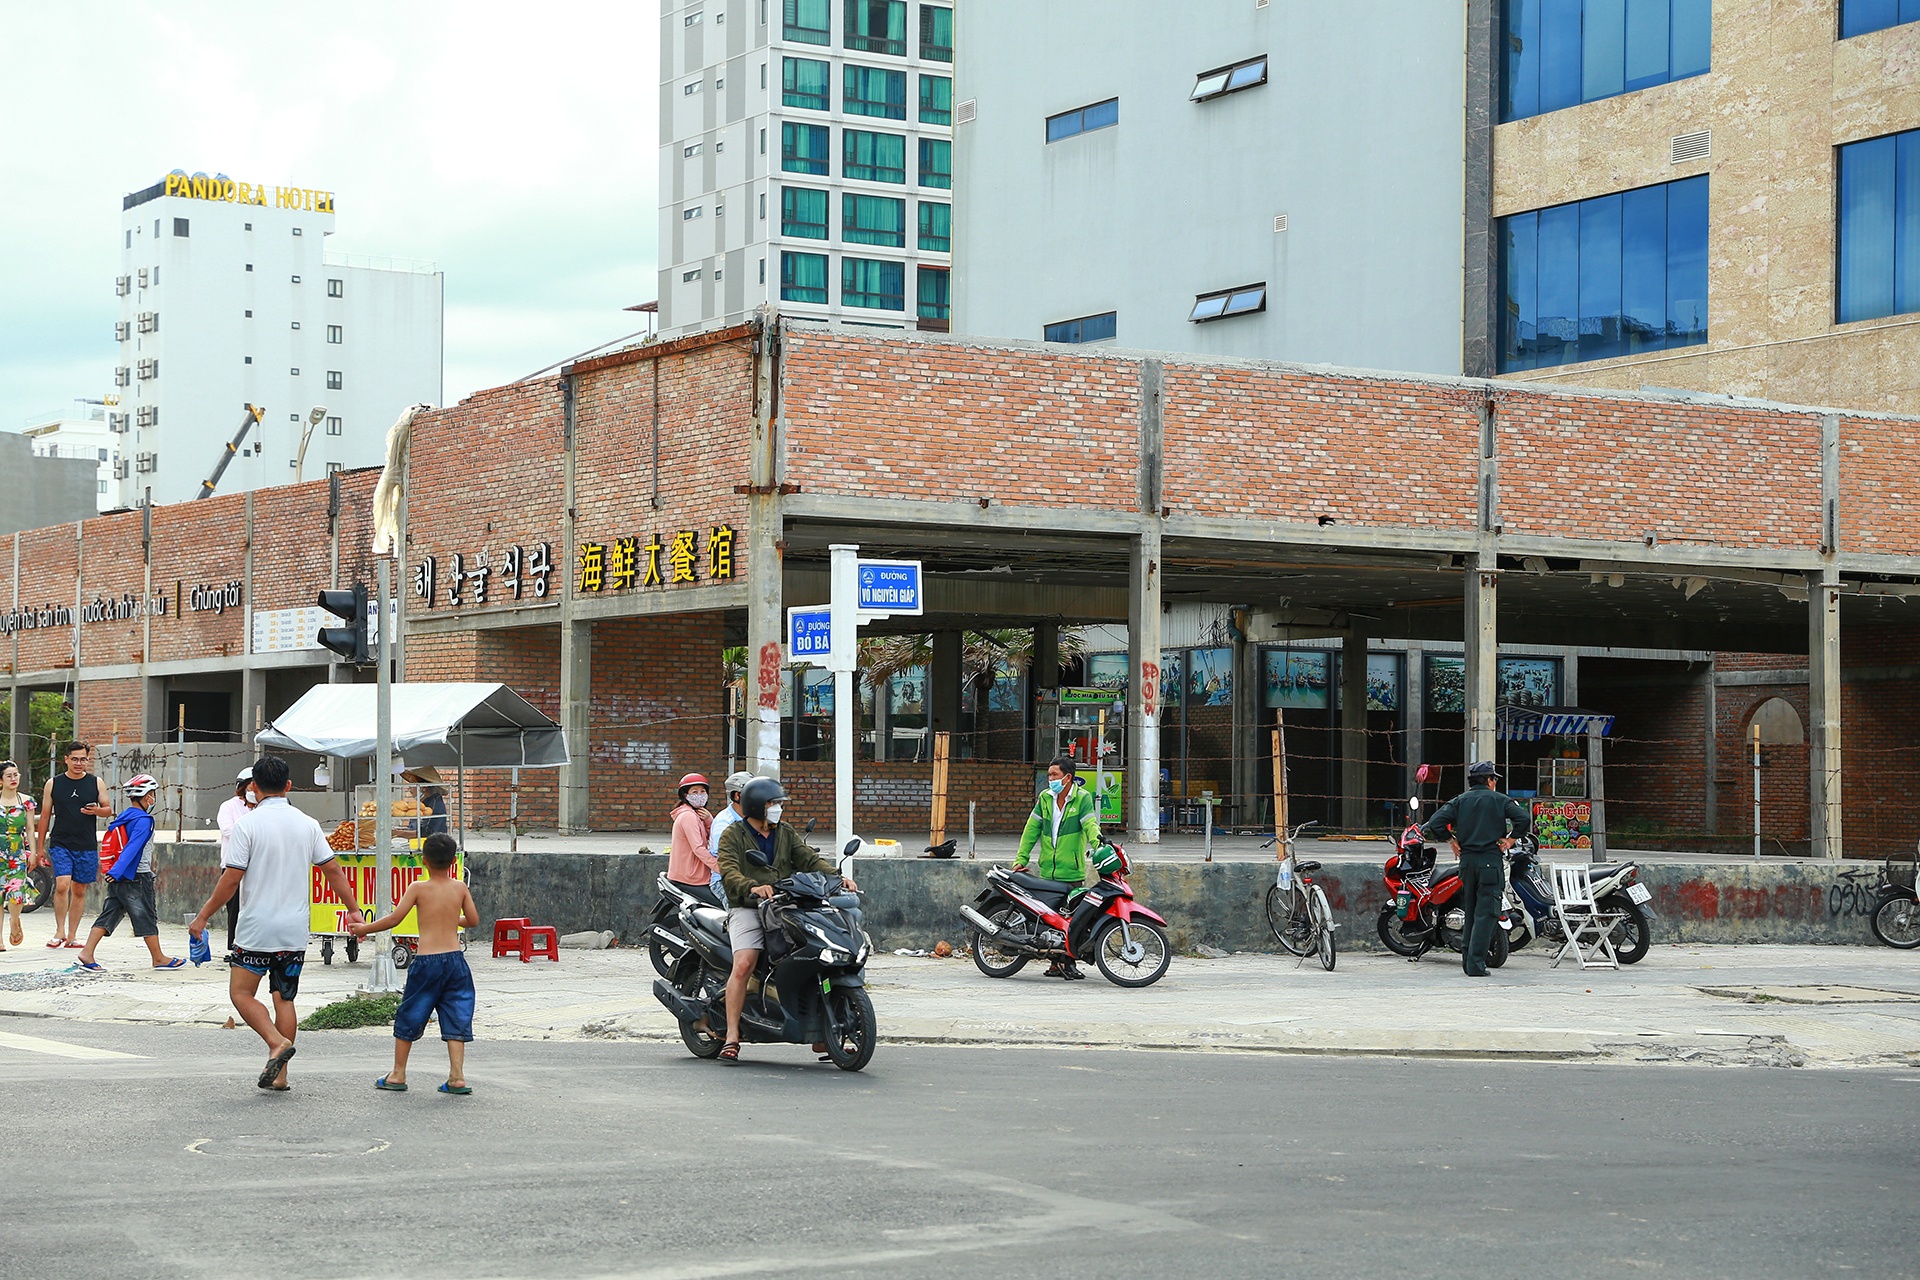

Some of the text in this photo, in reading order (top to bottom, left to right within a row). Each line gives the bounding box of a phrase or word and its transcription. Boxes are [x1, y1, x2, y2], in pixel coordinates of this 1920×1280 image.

[165, 174, 335, 214] PANDORA HOTEL
[579, 524, 733, 592] 海鲜大餐馆
[880, 570, 908, 581] ĐƯỜNG
[190, 581, 240, 615] Chúng tôi
[862, 585, 915, 602] VÕ NGUYÊN GIÁP
[808, 619, 831, 631] ĐƯỜNG
[797, 630, 830, 651] ĐỖ BÁ
[1537, 806, 1591, 815] Fresh Fruit
[242, 955, 271, 966] GUCCI
